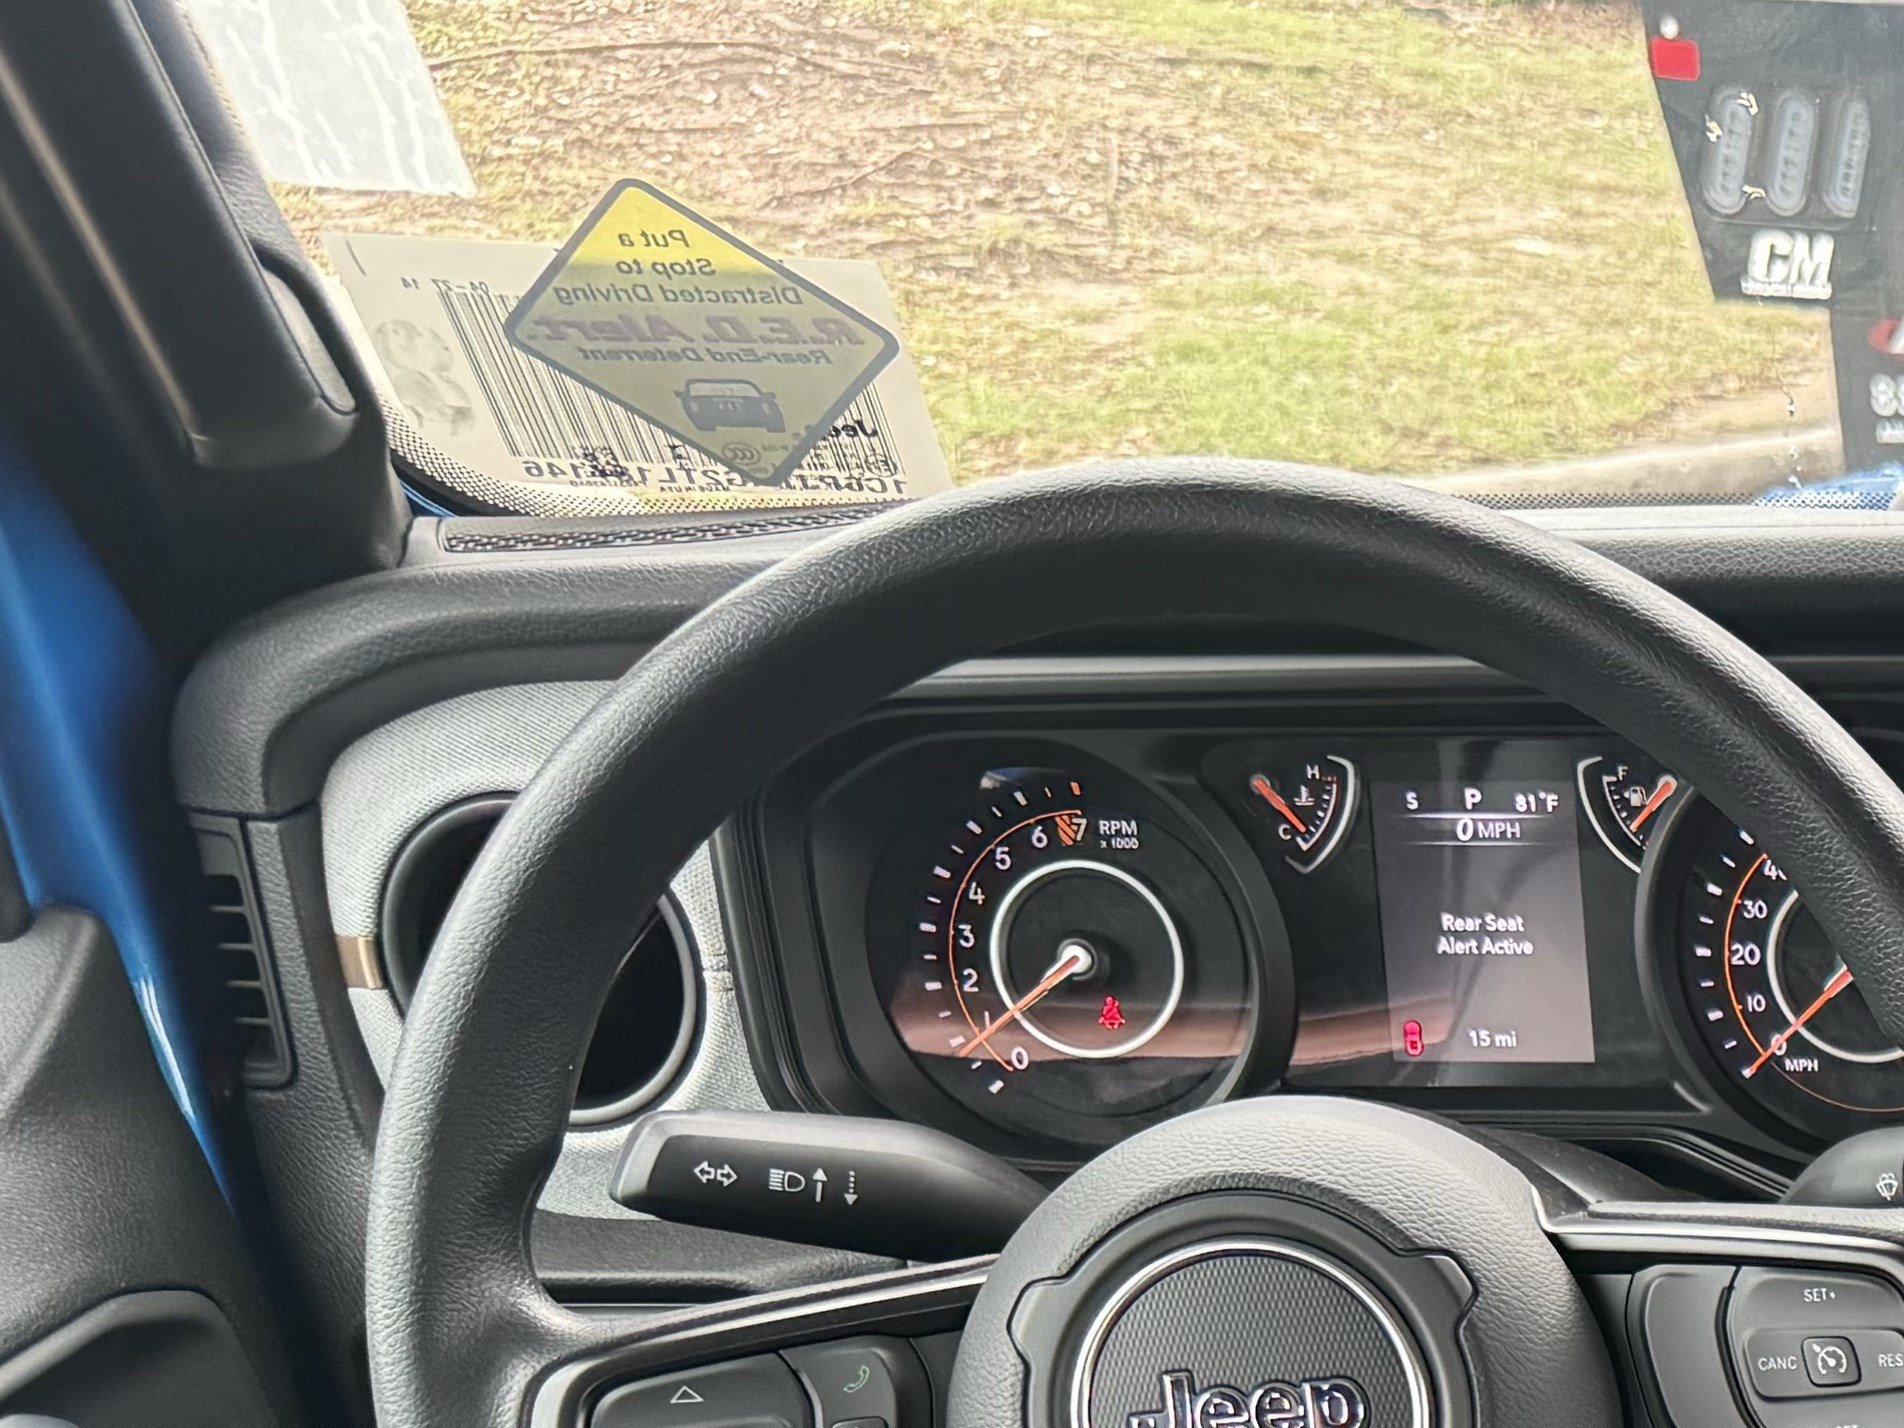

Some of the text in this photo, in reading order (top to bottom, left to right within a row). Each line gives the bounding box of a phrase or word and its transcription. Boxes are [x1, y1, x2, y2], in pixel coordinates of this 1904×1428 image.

[1748, 229, 1834, 287] CM
[1307, 765, 1320, 779] H
[1618, 766, 1628, 780] F
[1405, 788, 1559, 813] S P 81°F
[1071, 818, 1088, 841] 7
[1098, 820, 1138, 836] RPM
[1279, 825, 1291, 840] C
[1456, 818, 1521, 841] 0 MPH
[1031, 827, 1048, 849] 6
[1111, 837, 1139, 849] 1000
[995, 849, 1011, 871] 5
[968, 882, 985, 904] 4
[1743, 900, 1768, 918] 30
[1442, 913, 1524, 932] Rear Seat
[959, 925, 975, 947] 3
[1437, 937, 1533, 955] Alert Active
[1730, 945, 1762, 966] 20
[962, 970, 978, 993] 2
[1747, 995, 1766, 1012] 10
[1469, 1030, 1517, 1047] 15 mi
[1770, 1034, 1787, 1056] 0
[1011, 1047, 1029, 1069] 0
[1785, 1058, 1819, 1072] MPH
[1757, 1357, 1798, 1372] CANC
[1878, 1354, 1904, 1370] RES
